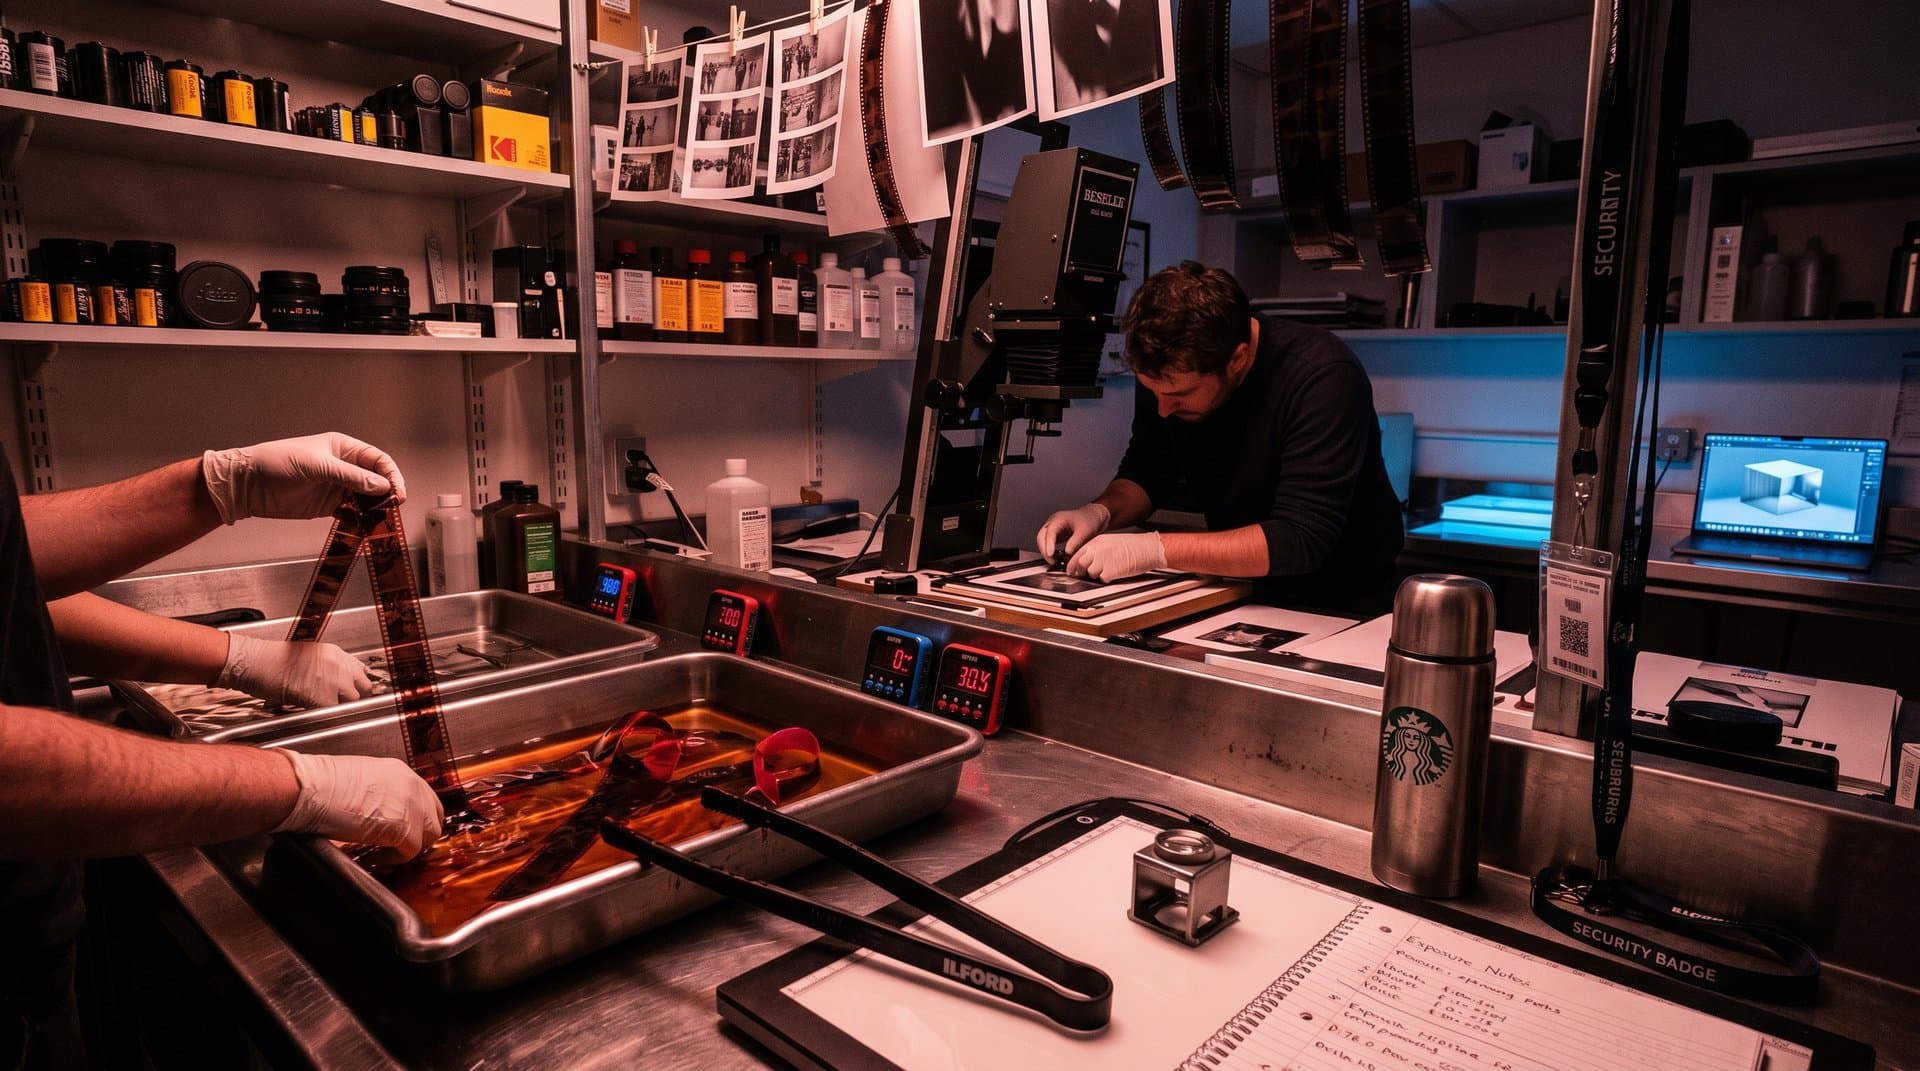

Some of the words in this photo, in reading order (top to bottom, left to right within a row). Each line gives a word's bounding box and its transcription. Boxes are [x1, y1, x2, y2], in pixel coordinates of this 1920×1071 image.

[1405, 935, 1473, 967] Exposure
[1572, 921, 1653, 961] SECURITY
[1655, 951, 1718, 982] BADGE
[943, 957, 1014, 995] ILFORD
